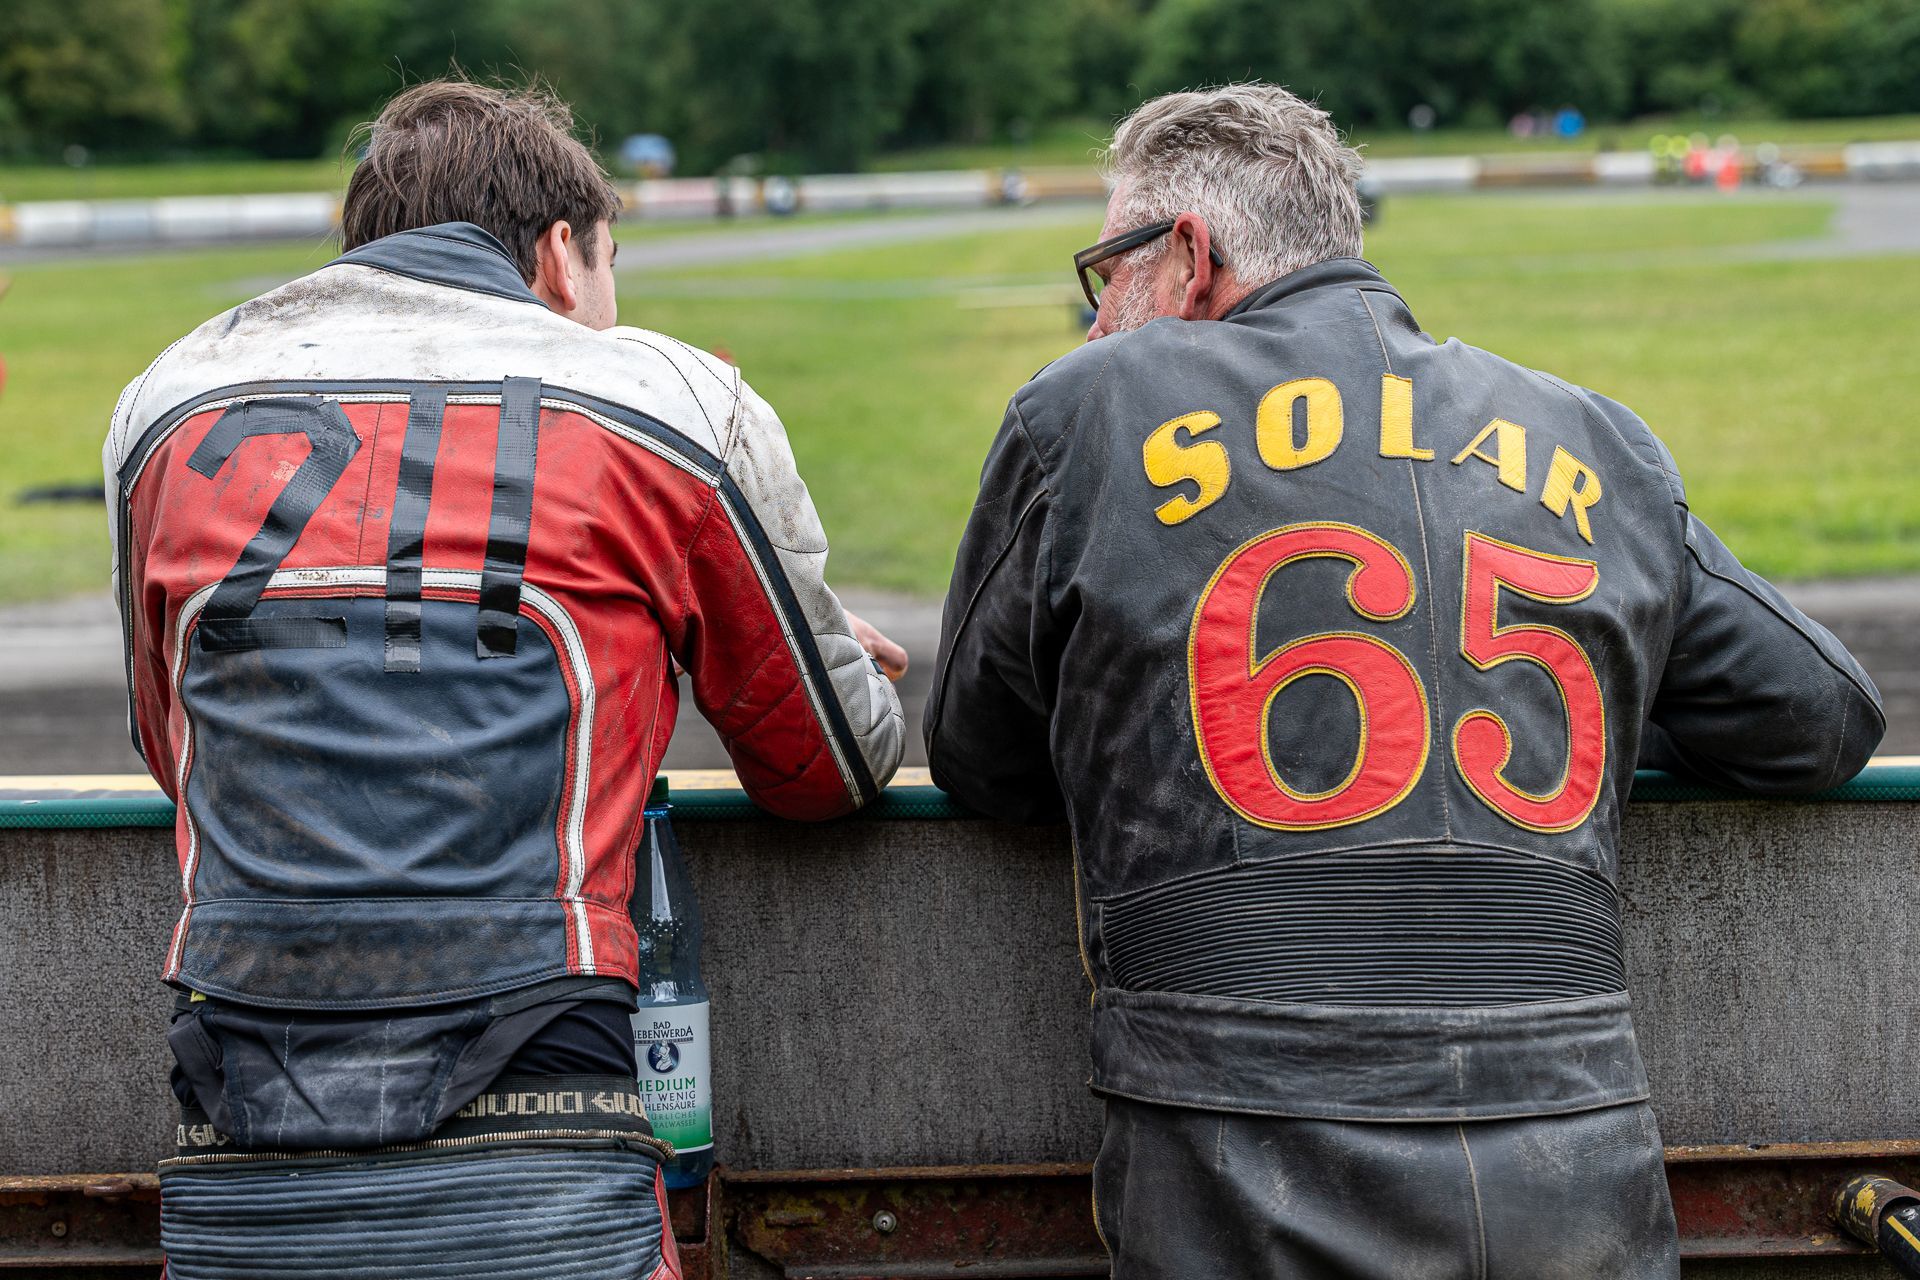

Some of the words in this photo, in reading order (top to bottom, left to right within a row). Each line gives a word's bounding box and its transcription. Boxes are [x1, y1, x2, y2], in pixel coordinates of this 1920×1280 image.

[1143, 373, 1602, 545] SOLAR
[1187, 521, 1605, 834] 65
[653, 1021, 671, 1030] BAD
[634, 1025, 694, 1039] IEBENWERDA
[641, 1093, 652, 1102] IT
[658, 1090, 696, 1102] WENIG
[644, 1100, 696, 1112] HLENSÄURE
[653, 1118, 697, 1129] RALWASSER
